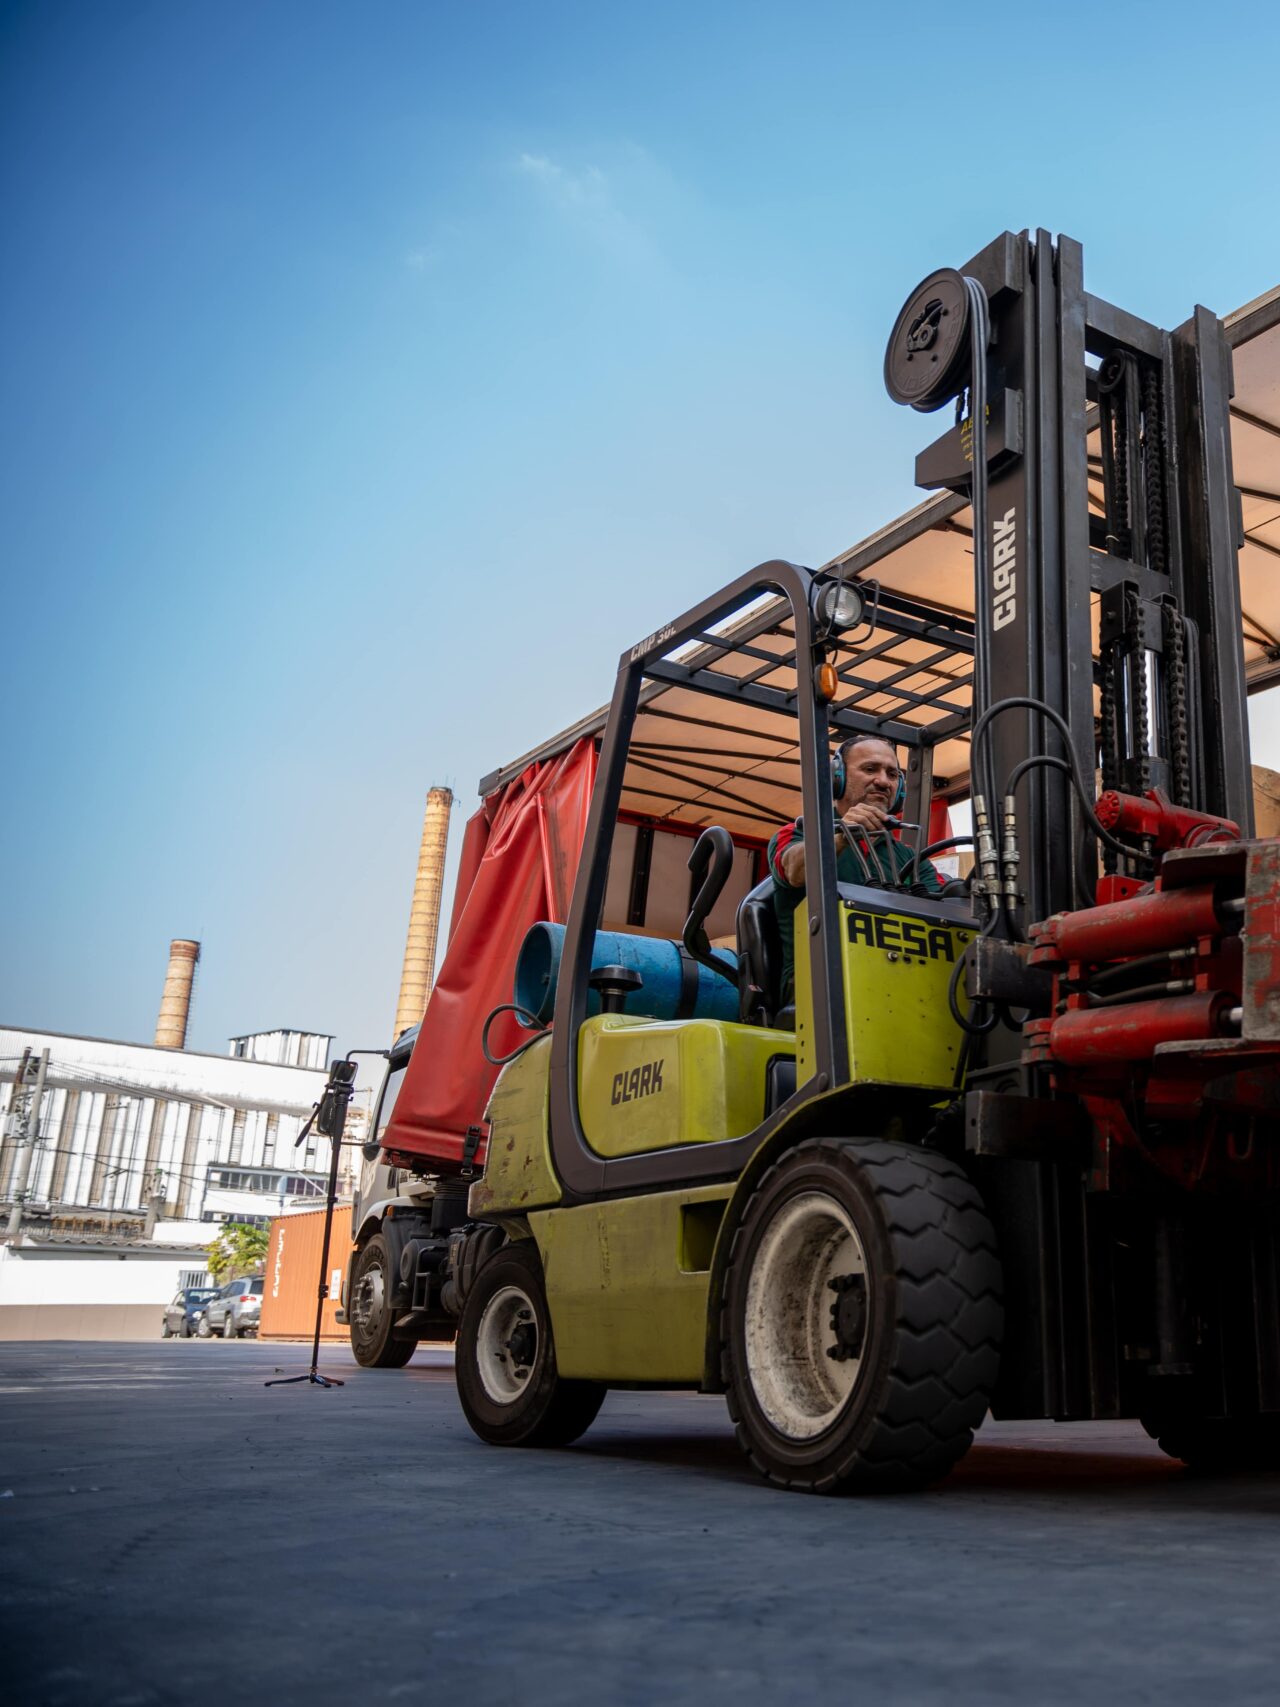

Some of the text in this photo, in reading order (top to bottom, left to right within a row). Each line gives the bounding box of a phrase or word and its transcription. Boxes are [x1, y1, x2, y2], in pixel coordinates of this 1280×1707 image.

[993, 507, 1016, 631] CLARK
[631, 634, 655, 661] CMP
[848, 912, 954, 962] AESA
[611, 1060, 664, 1106] CLARK
